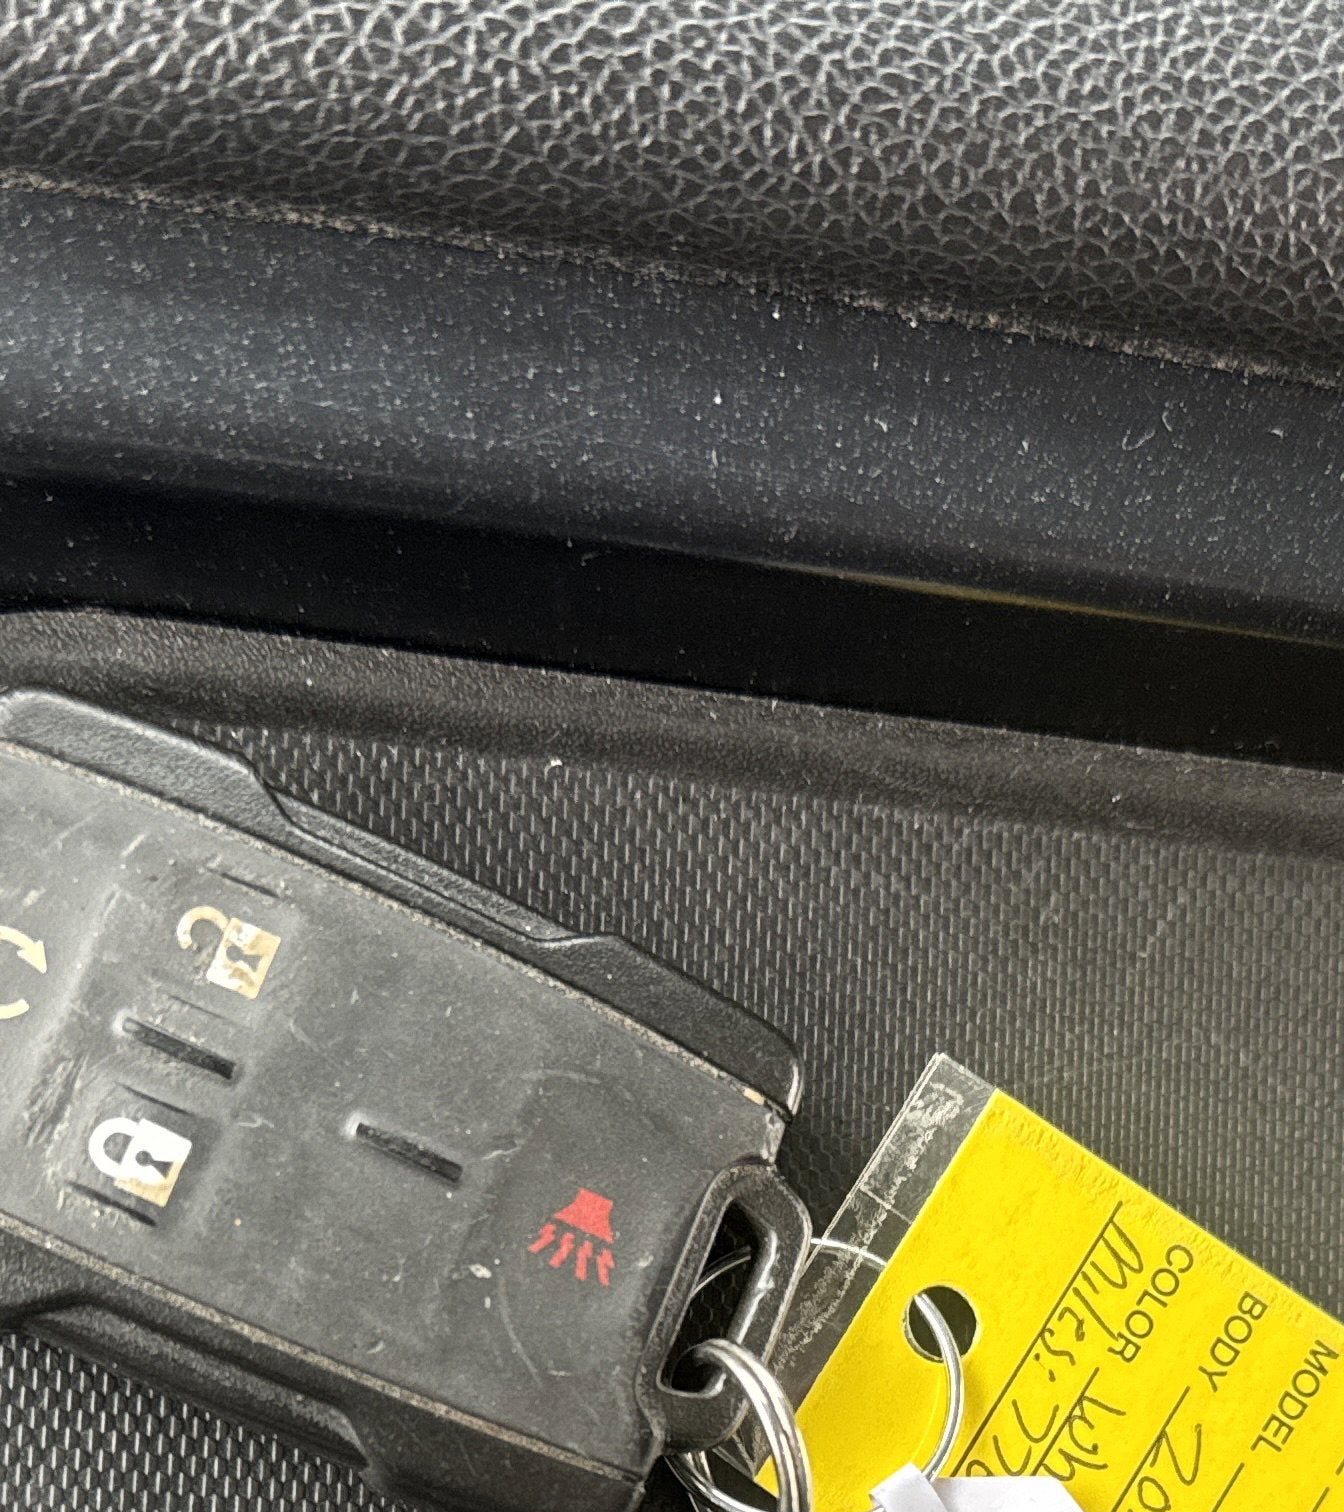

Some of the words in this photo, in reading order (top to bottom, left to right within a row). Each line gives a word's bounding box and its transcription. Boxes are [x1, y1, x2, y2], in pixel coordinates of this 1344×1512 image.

[1108, 1245, 1194, 1362] COLOR
[1198, 1291, 1268, 1392] BODY
[1250, 1340, 1339, 1452] MODEL
